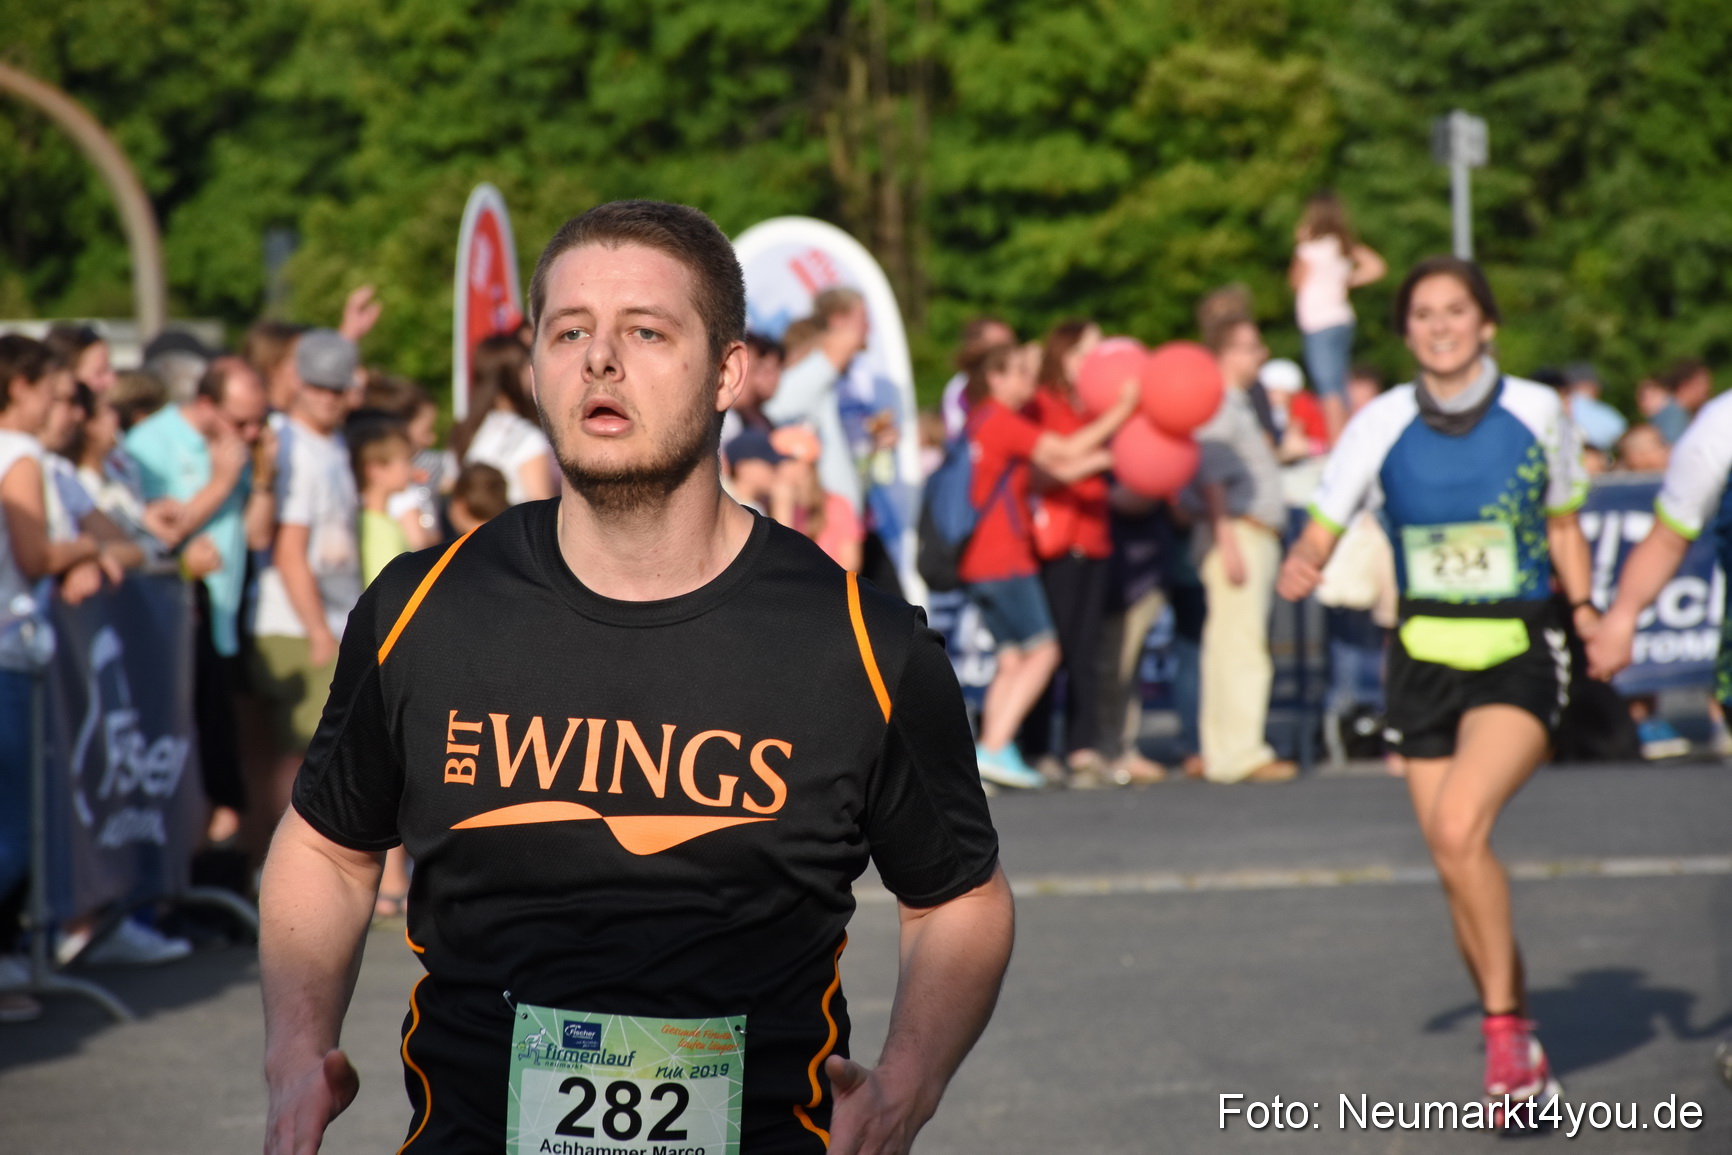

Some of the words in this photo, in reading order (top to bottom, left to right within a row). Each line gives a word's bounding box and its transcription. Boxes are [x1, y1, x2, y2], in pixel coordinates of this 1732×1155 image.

[1433, 546, 1489, 577] 234
[443, 709, 483, 786] BIT
[488, 712, 793, 815] WINGS
[545, 1061, 583, 1070] neumarkt
[546, 1043, 636, 1067] firmenlauf
[655, 1065, 684, 1079] run
[689, 1063, 729, 1079] 2019
[554, 1076, 690, 1142] 282
[539, 1138, 647, 1155] Achhammer
[653, 1145, 706, 1155] Marco
